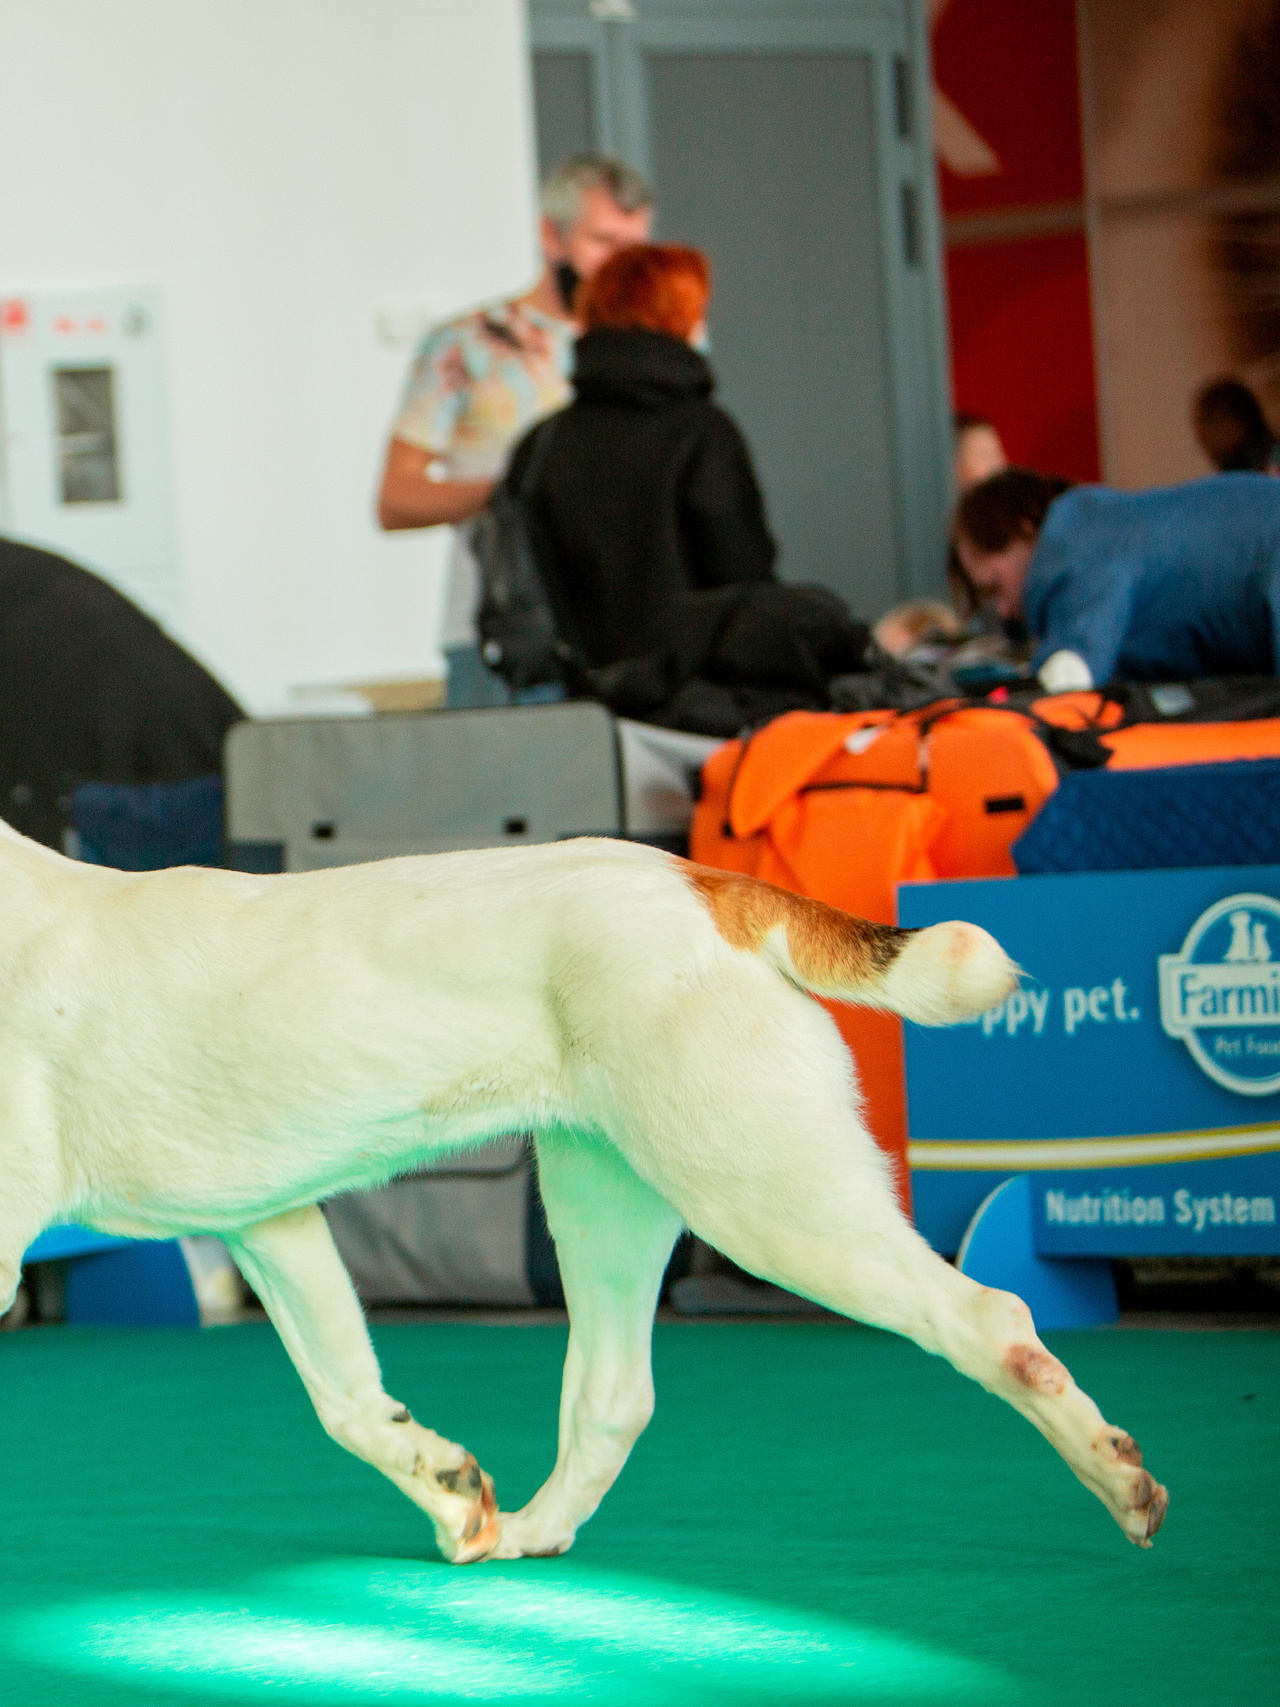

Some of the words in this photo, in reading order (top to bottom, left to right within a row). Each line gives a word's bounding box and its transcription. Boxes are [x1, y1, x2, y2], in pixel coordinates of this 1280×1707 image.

[968, 988, 1049, 1036] ppy
[1064, 977, 1140, 1035] pet.
[1179, 969, 1280, 1016] Farmi
[1045, 1188, 1166, 1225] Nutrition
[1173, 1188, 1276, 1231] System
